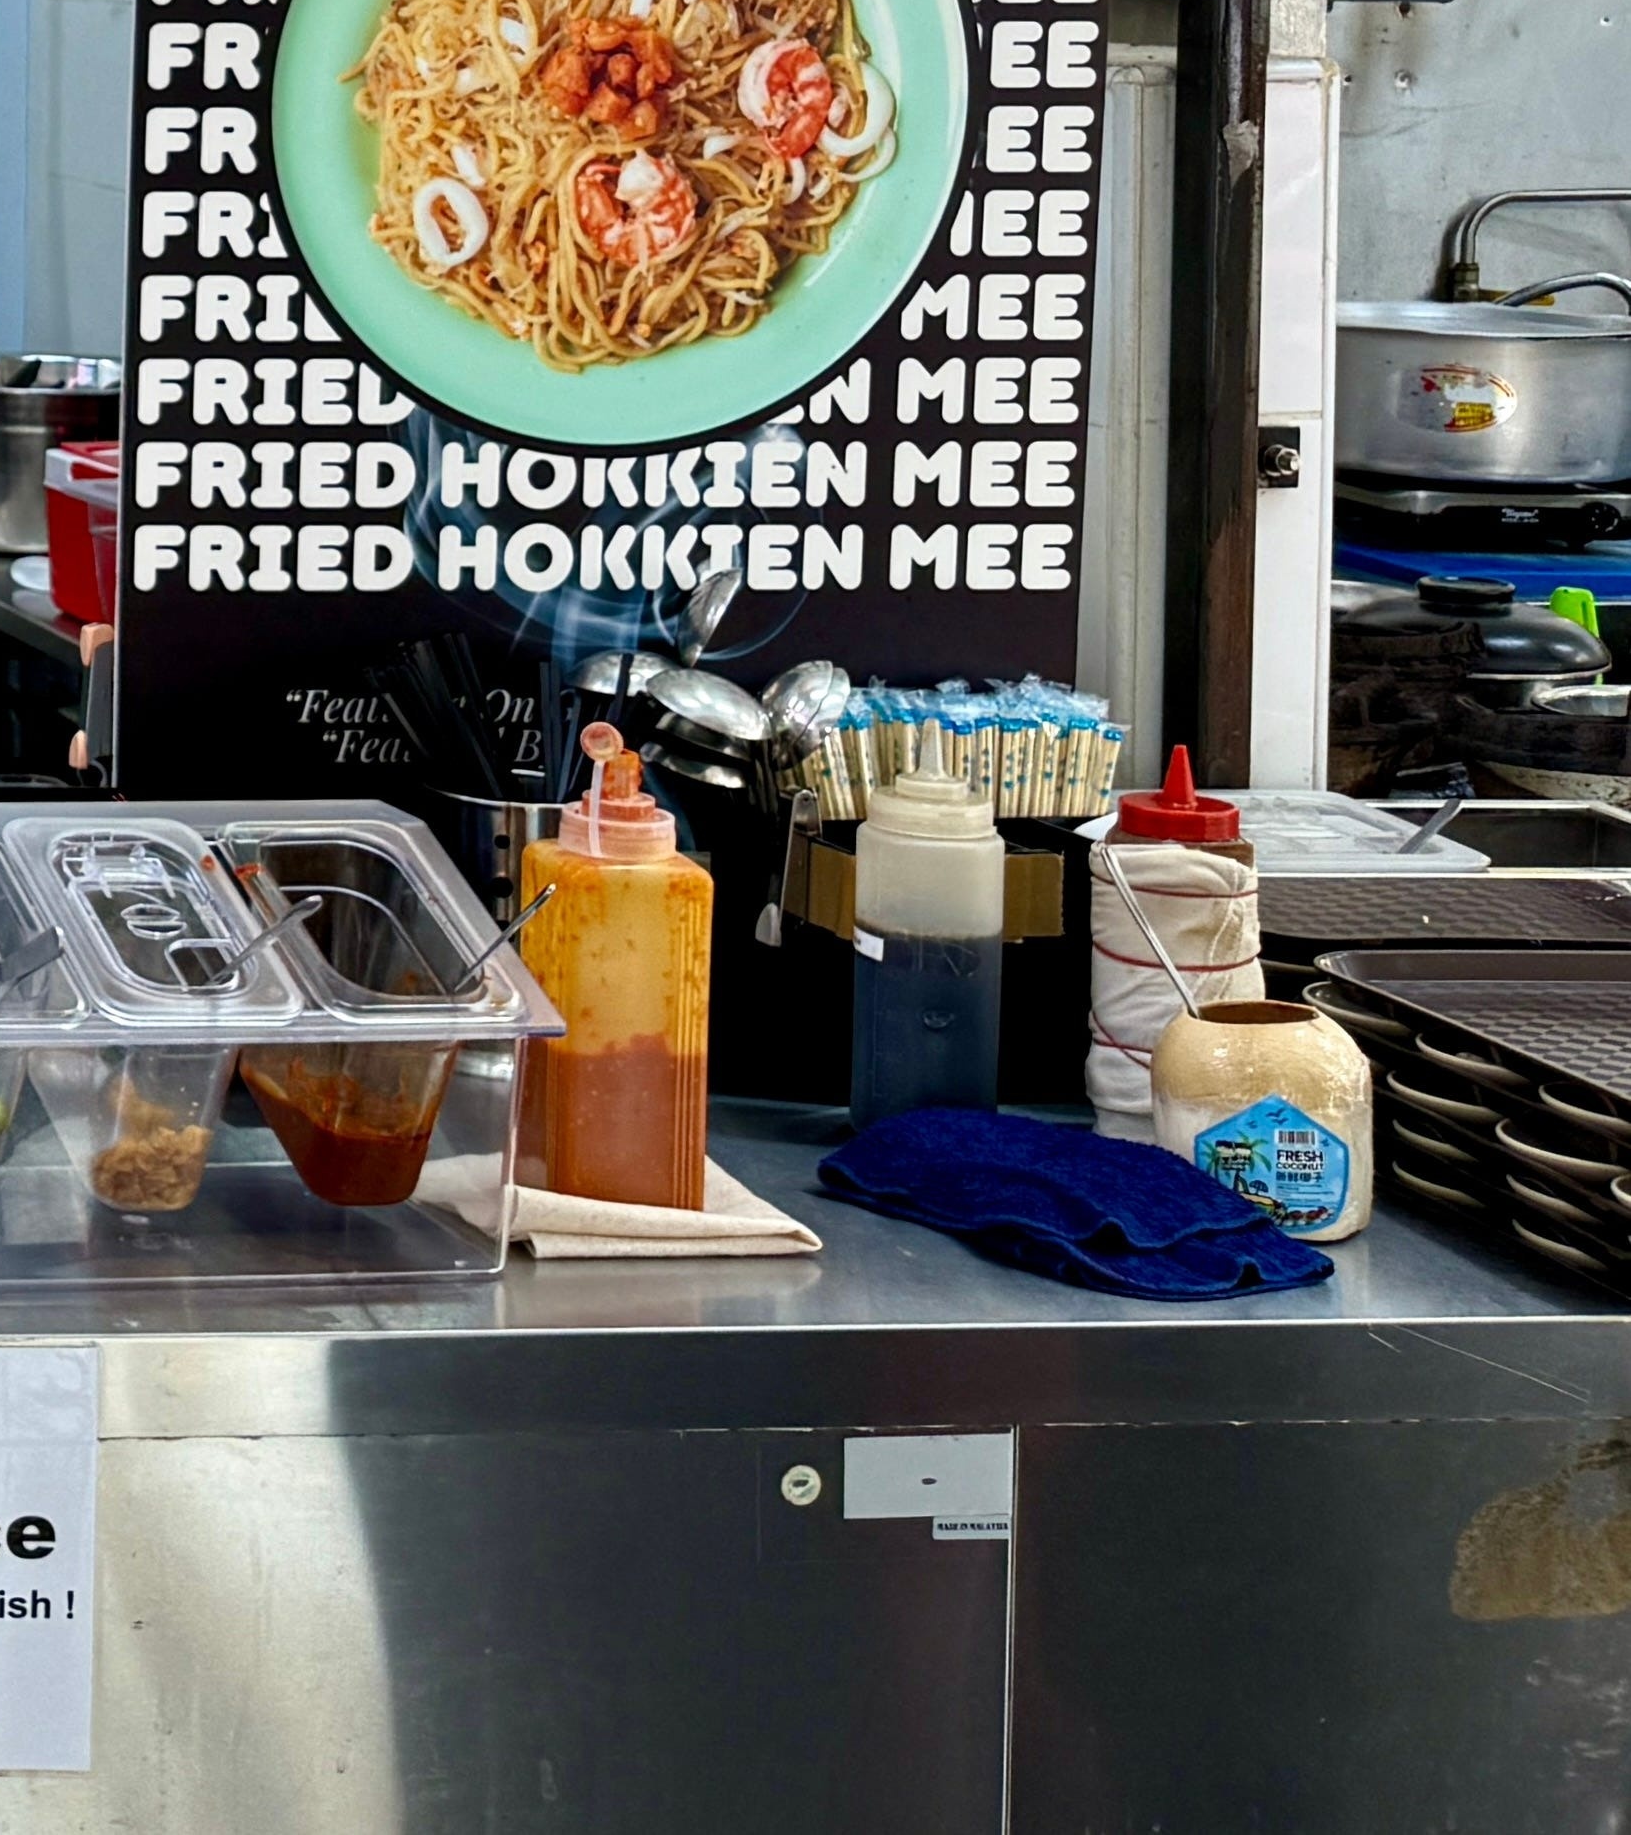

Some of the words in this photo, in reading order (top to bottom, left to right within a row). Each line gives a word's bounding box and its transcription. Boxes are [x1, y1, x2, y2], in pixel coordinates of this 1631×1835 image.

[900, 274, 1086, 341] MEE
[896, 357, 1082, 424] MEE
[135, 441, 416, 508] FRIED
[441, 441, 868, 510] HOKKIEN
[892, 440, 1078, 508] MEE
[133, 525, 415, 592] FRIED
[437, 522, 865, 592] HOKKIEN
[889, 523, 1074, 591] MEE
[1276, 1162, 1324, 1171] COCONUT
[1277, 1149, 1324, 1162] FRESH
